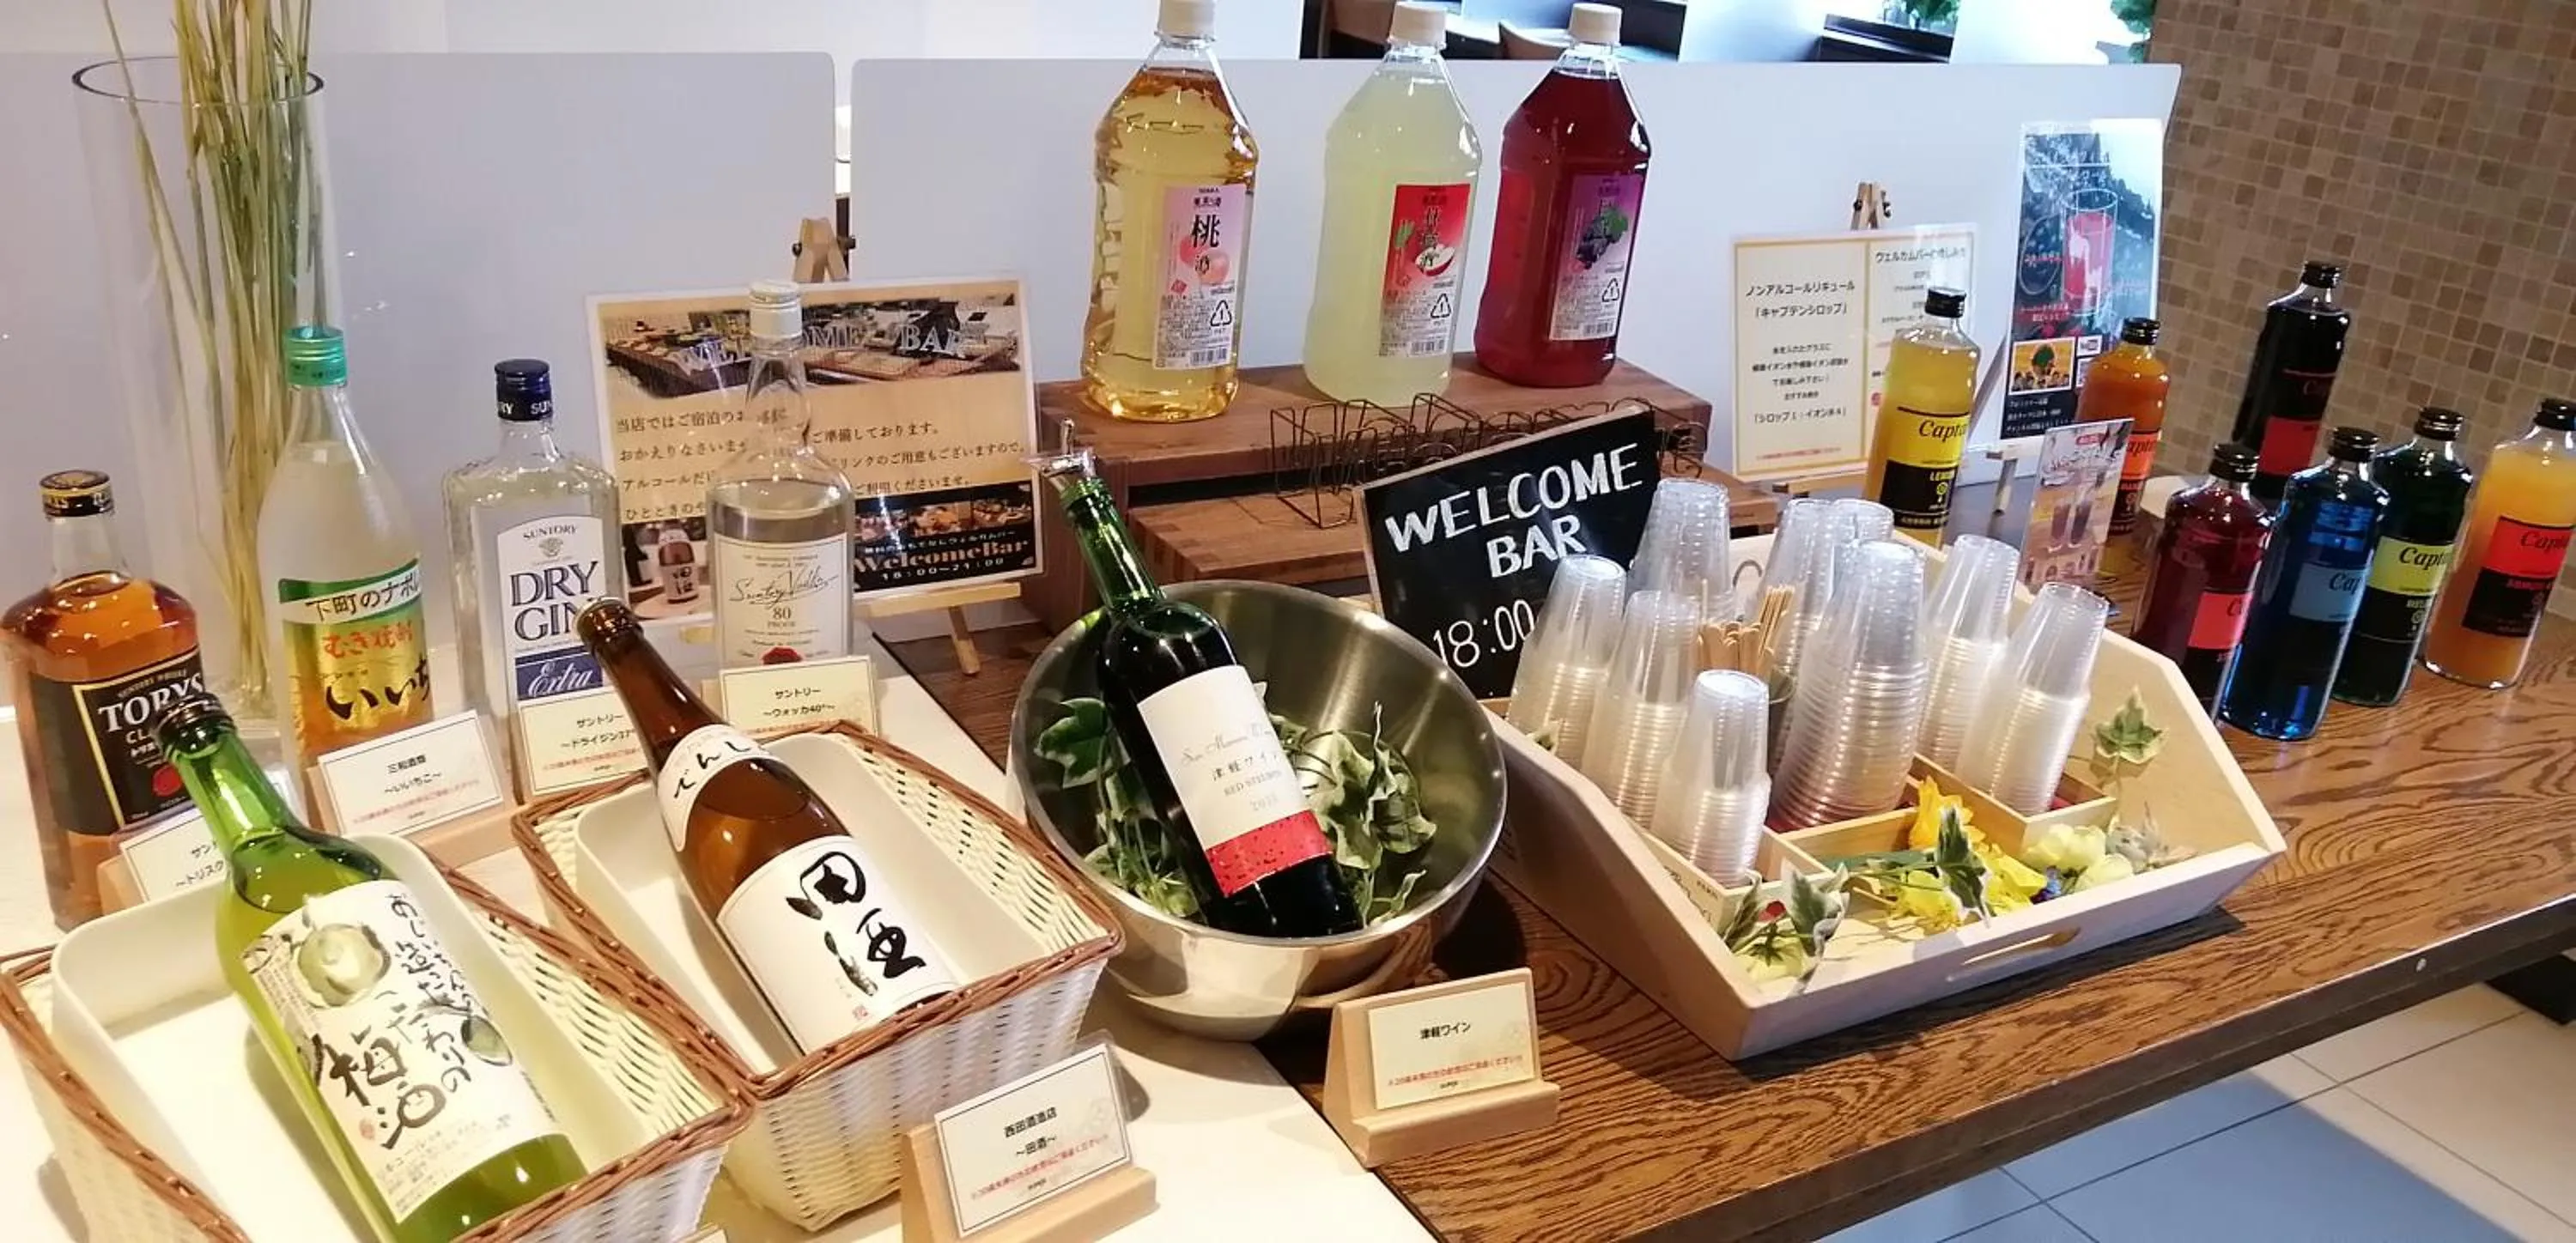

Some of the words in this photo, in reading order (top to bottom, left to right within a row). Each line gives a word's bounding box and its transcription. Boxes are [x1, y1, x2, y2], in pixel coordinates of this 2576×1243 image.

[1746, 280, 1855, 297] ノンアルコールリキュール
[1384, 443, 1643, 553] WELCOME
[1486, 514, 1587, 578] BAR
[509, 561, 598, 606] DRY
[773, 607, 792, 620] 80
[775, 687, 822, 700] サントリー
[1419, 1022, 1471, 1040] 津軽ワイン
[1004, 1106, 1058, 1138] 西田酒造店
